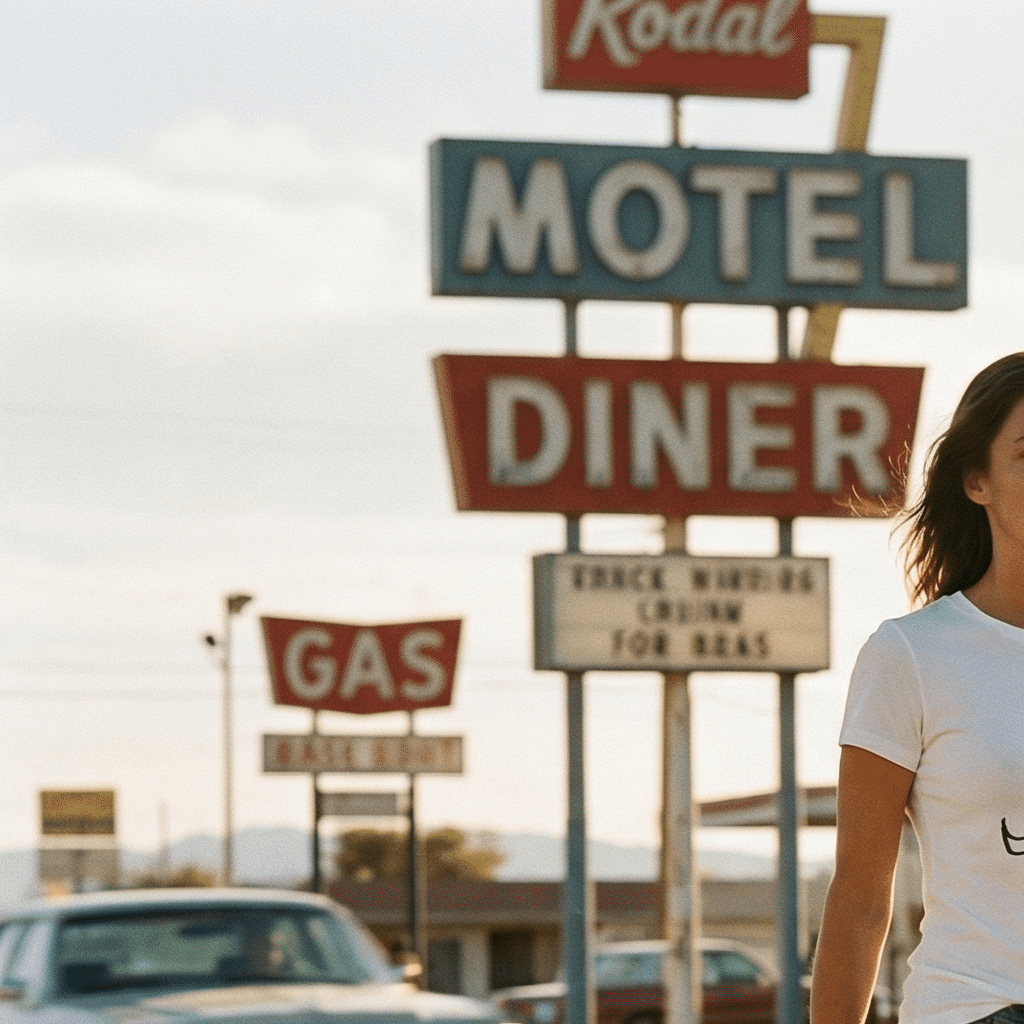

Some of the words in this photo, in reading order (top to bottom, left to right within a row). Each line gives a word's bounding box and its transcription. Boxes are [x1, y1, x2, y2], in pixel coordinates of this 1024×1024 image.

[457, 156, 961, 289] MOTEL
[485, 376, 896, 496] DINER
[282, 628, 449, 702] GAS
